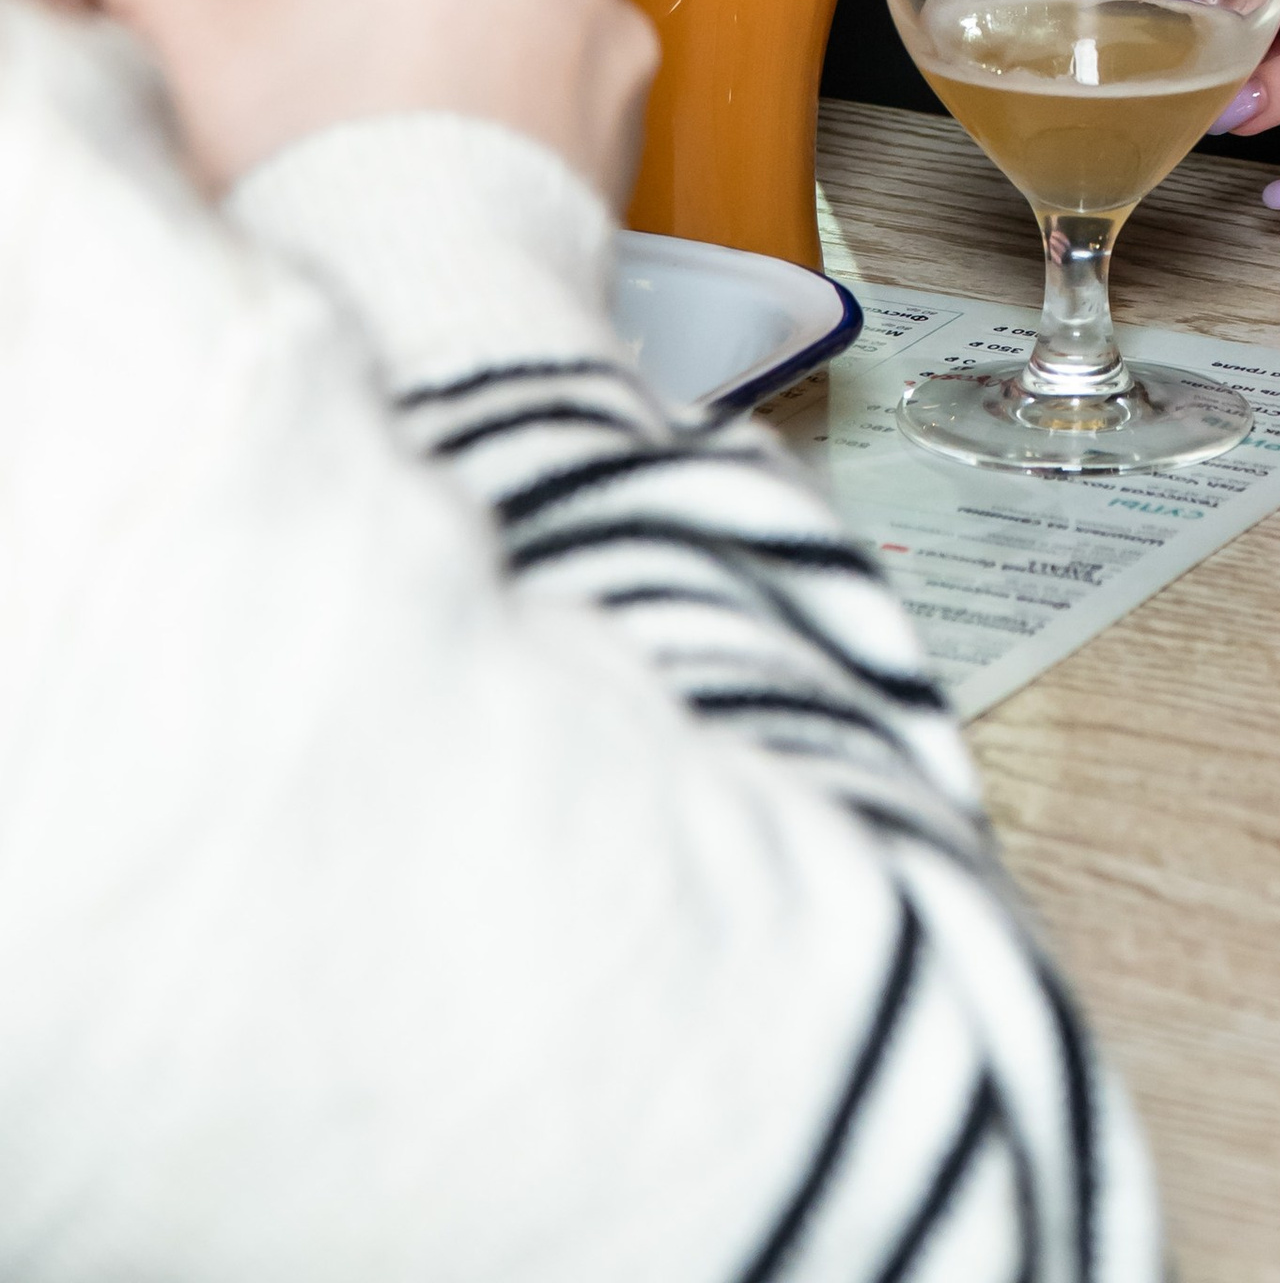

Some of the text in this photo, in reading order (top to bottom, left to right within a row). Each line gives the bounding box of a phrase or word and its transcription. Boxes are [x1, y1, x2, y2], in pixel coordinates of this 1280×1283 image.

[987, 344, 1024, 353] 350
[1211, 362, 1267, 375] гриле
[1108, 498, 1204, 519] СУПЫ
